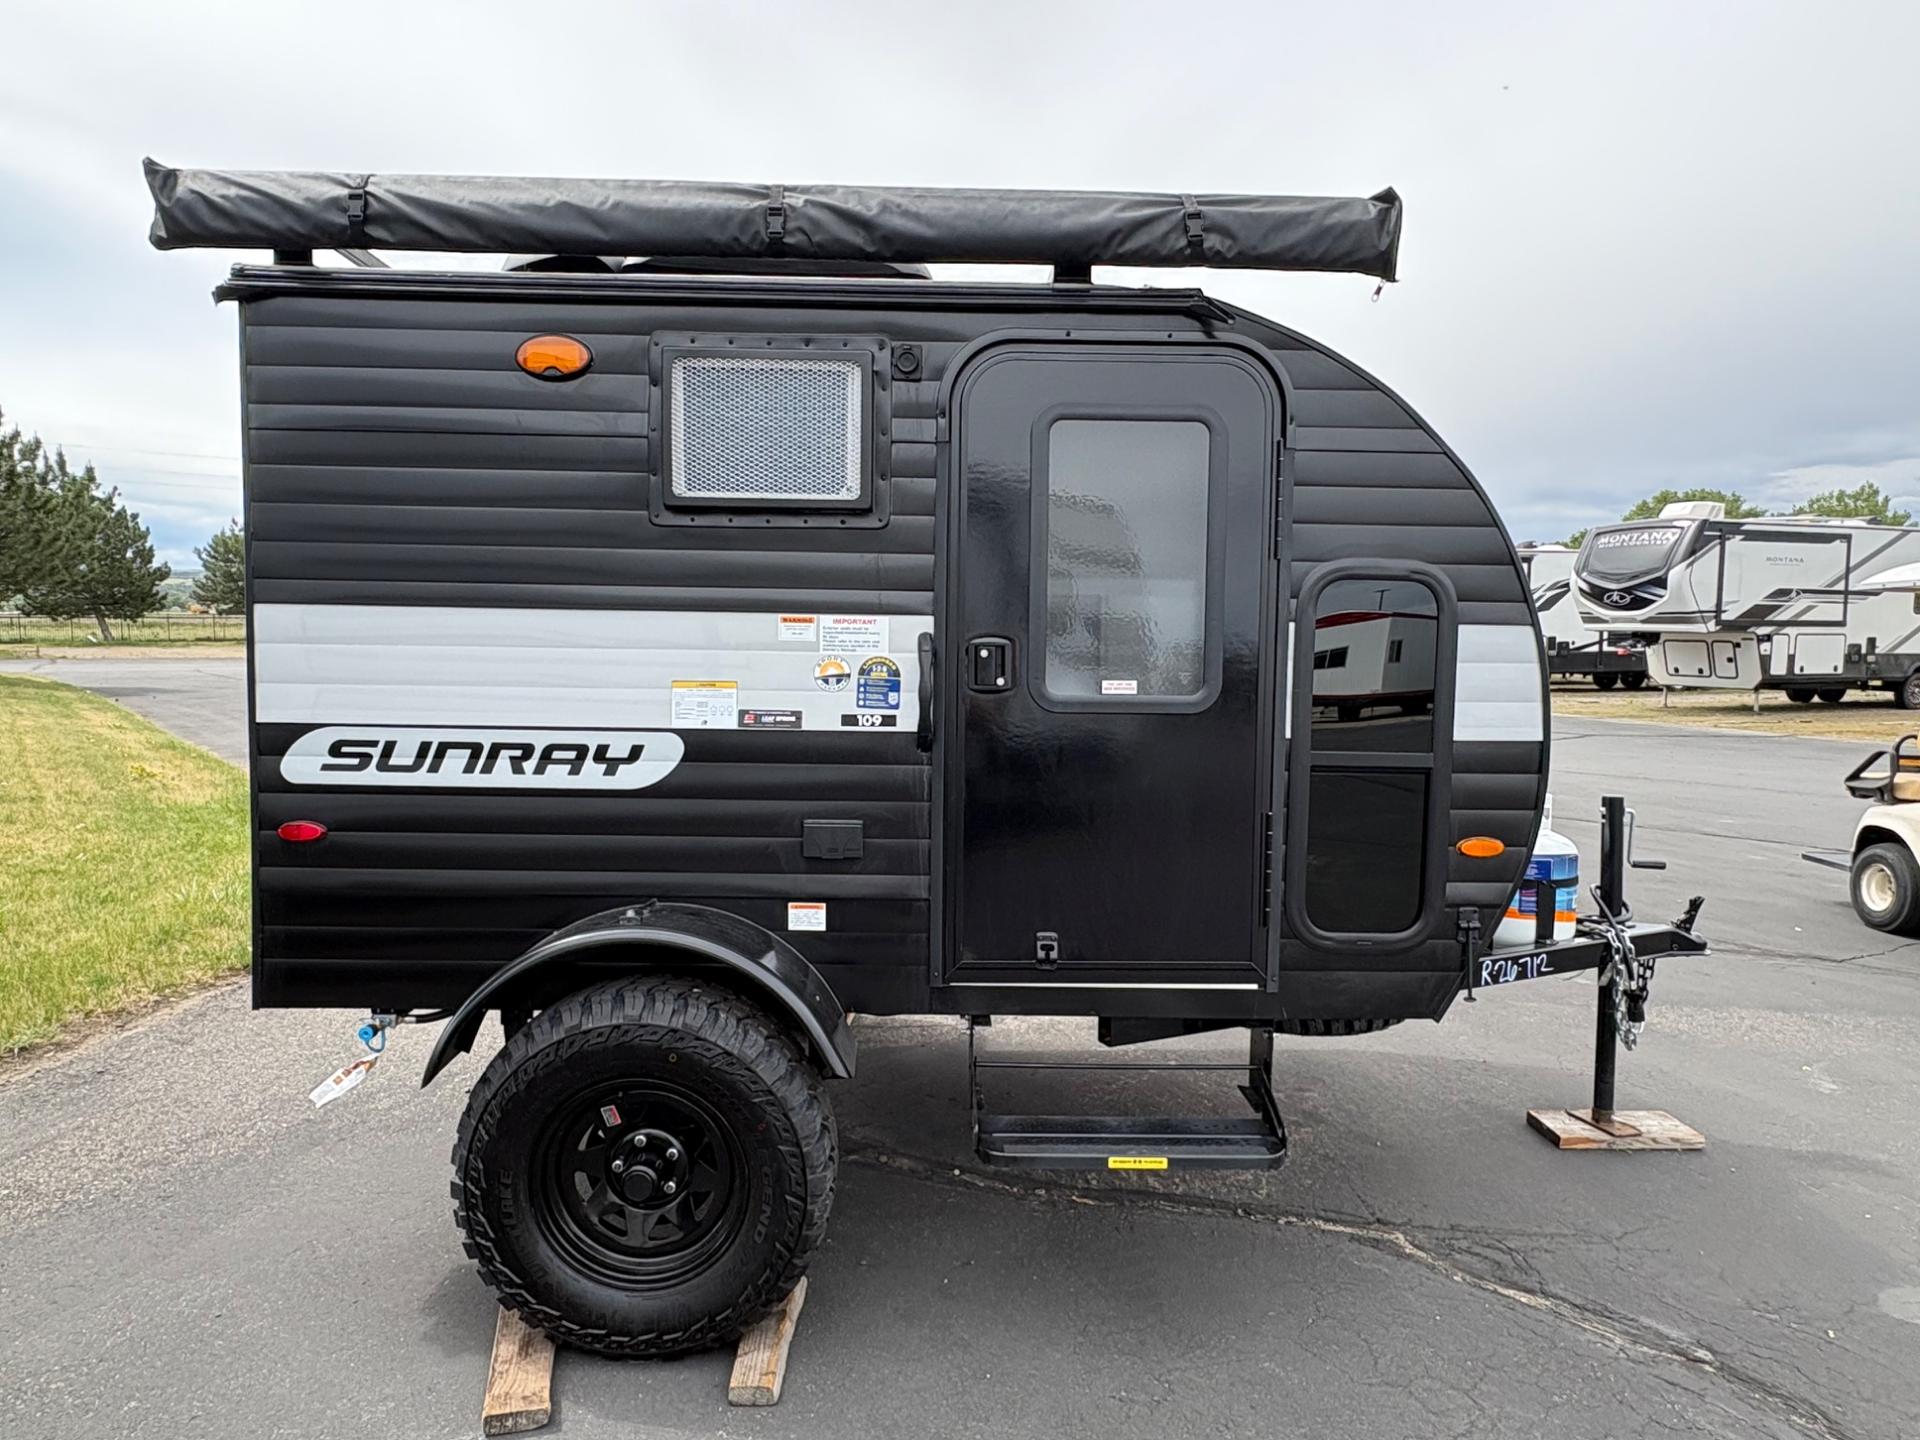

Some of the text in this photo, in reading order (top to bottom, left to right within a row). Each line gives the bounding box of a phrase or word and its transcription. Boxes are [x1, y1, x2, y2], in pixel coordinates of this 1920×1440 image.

[1598, 531, 1674, 544] MONTANA
[857, 714, 882, 727] 109
[320, 739, 645, 777] SUNRAY
